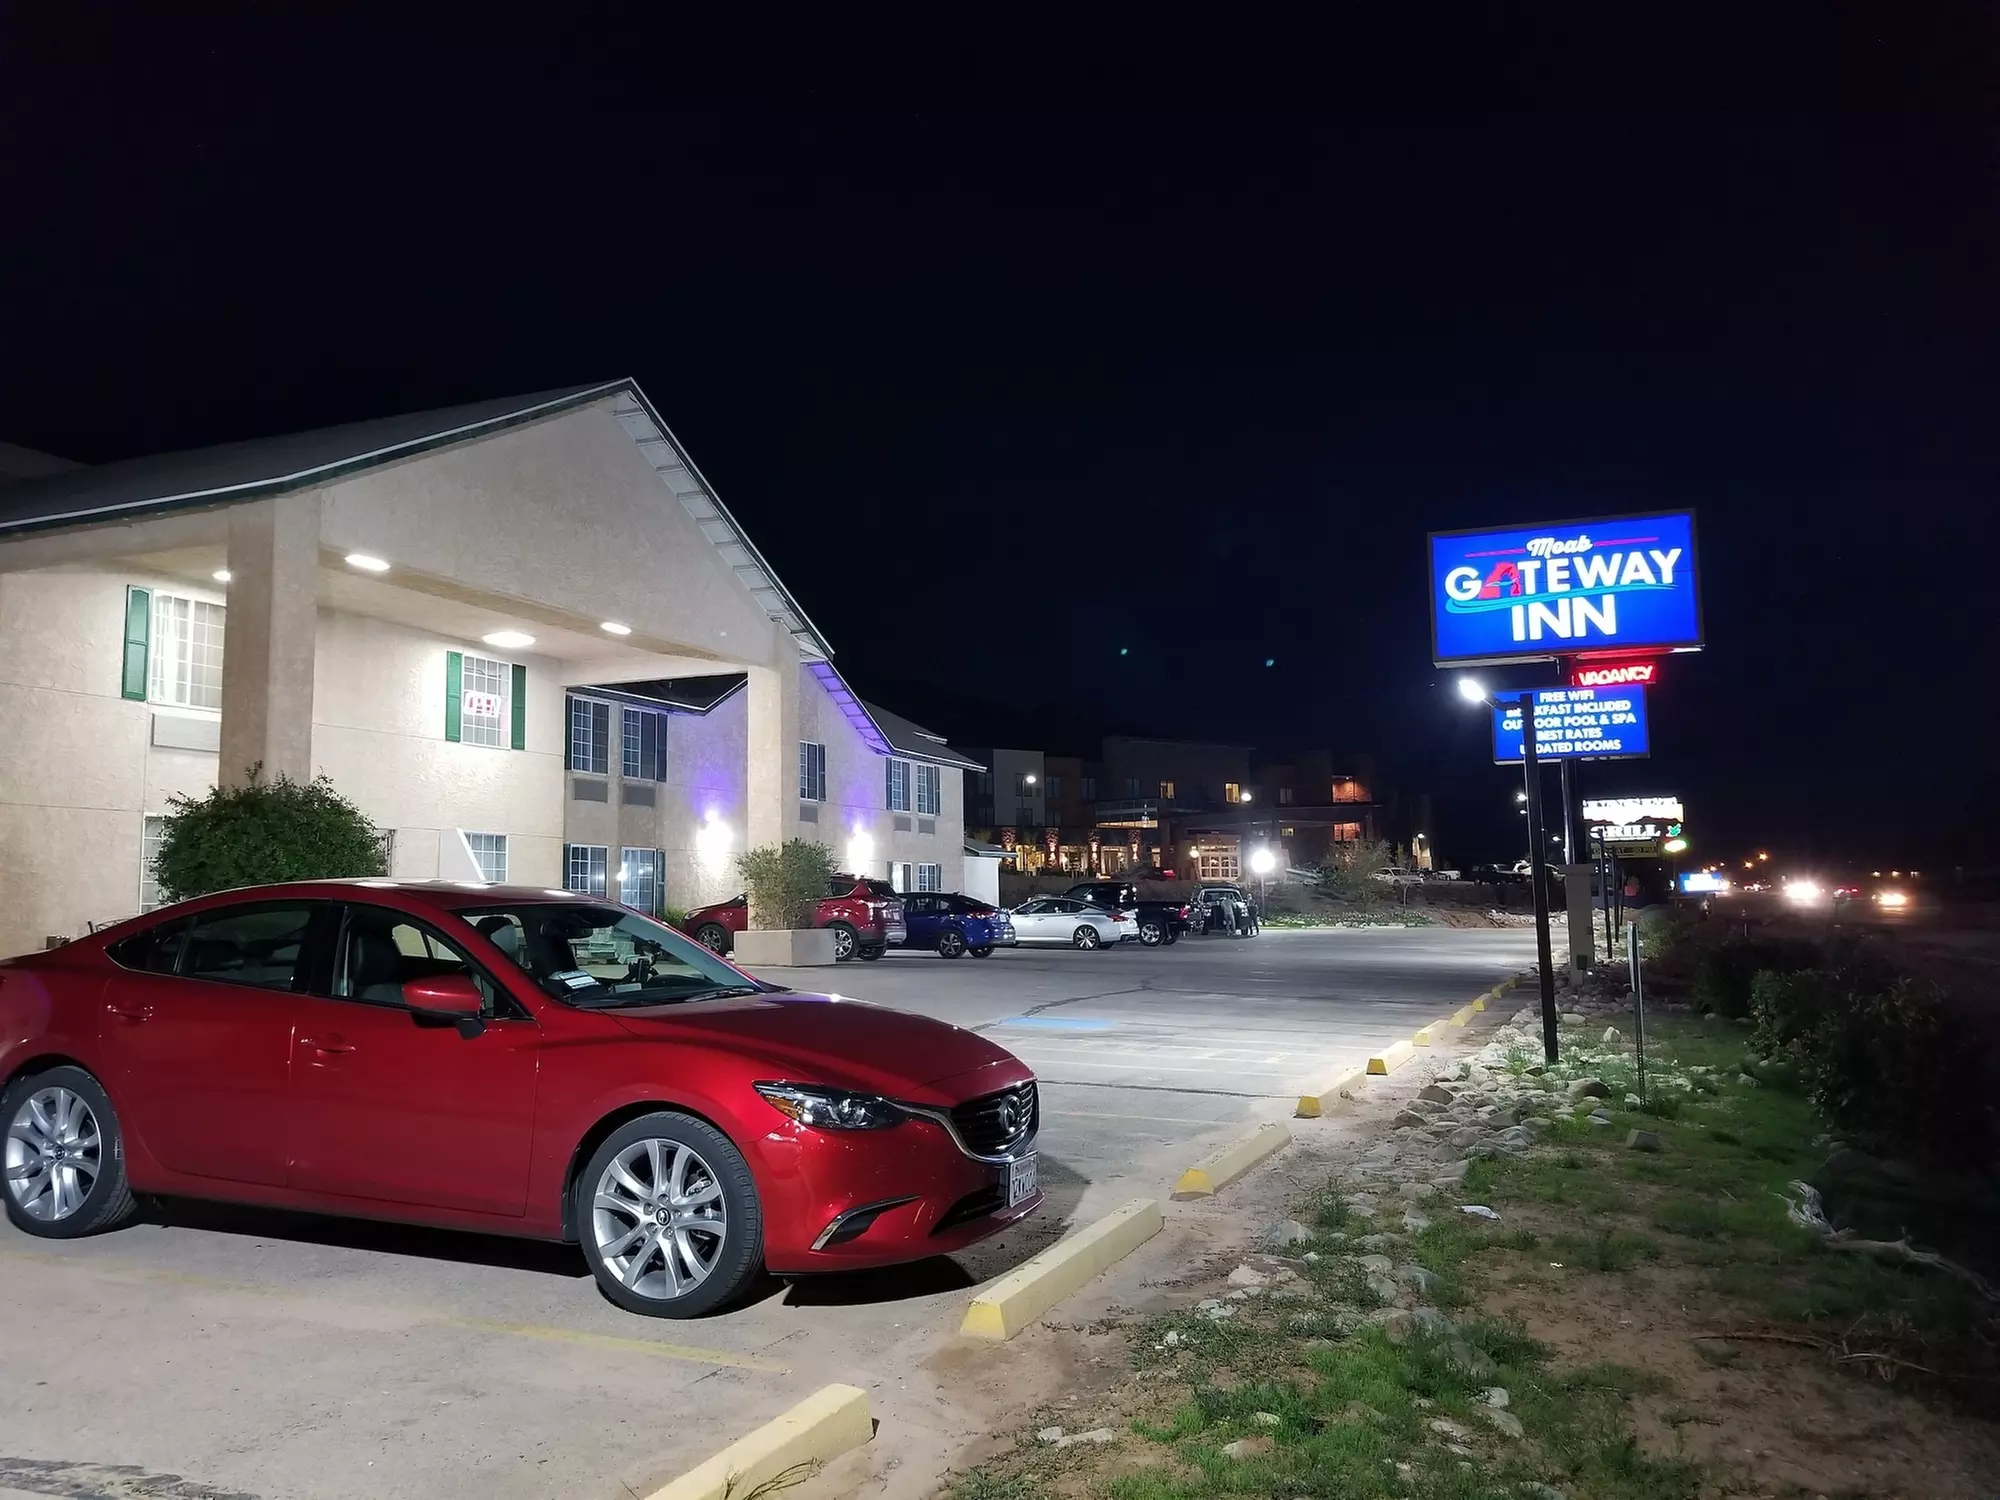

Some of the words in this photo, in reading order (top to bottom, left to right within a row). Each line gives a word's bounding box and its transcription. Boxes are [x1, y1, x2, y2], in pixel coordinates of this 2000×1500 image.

[1526, 535, 1593, 559] Moab
[1444, 548, 1682, 601] GATEWAY
[1511, 594, 1617, 642] INN
[1578, 666, 1653, 686] VACANCY
[1539, 691, 1567, 703] FREE
[1568, 689, 1595, 701] WIFI
[1574, 700, 1632, 714] INCLUDED
[1564, 714, 1598, 727] POOL
[1600, 714, 1609, 726] &
[1612, 712, 1637, 725] SPA
[1536, 730, 1564, 742] BEST
[1566, 727, 1603, 740] RATES
[1575, 739, 1622, 752] ROOMS
